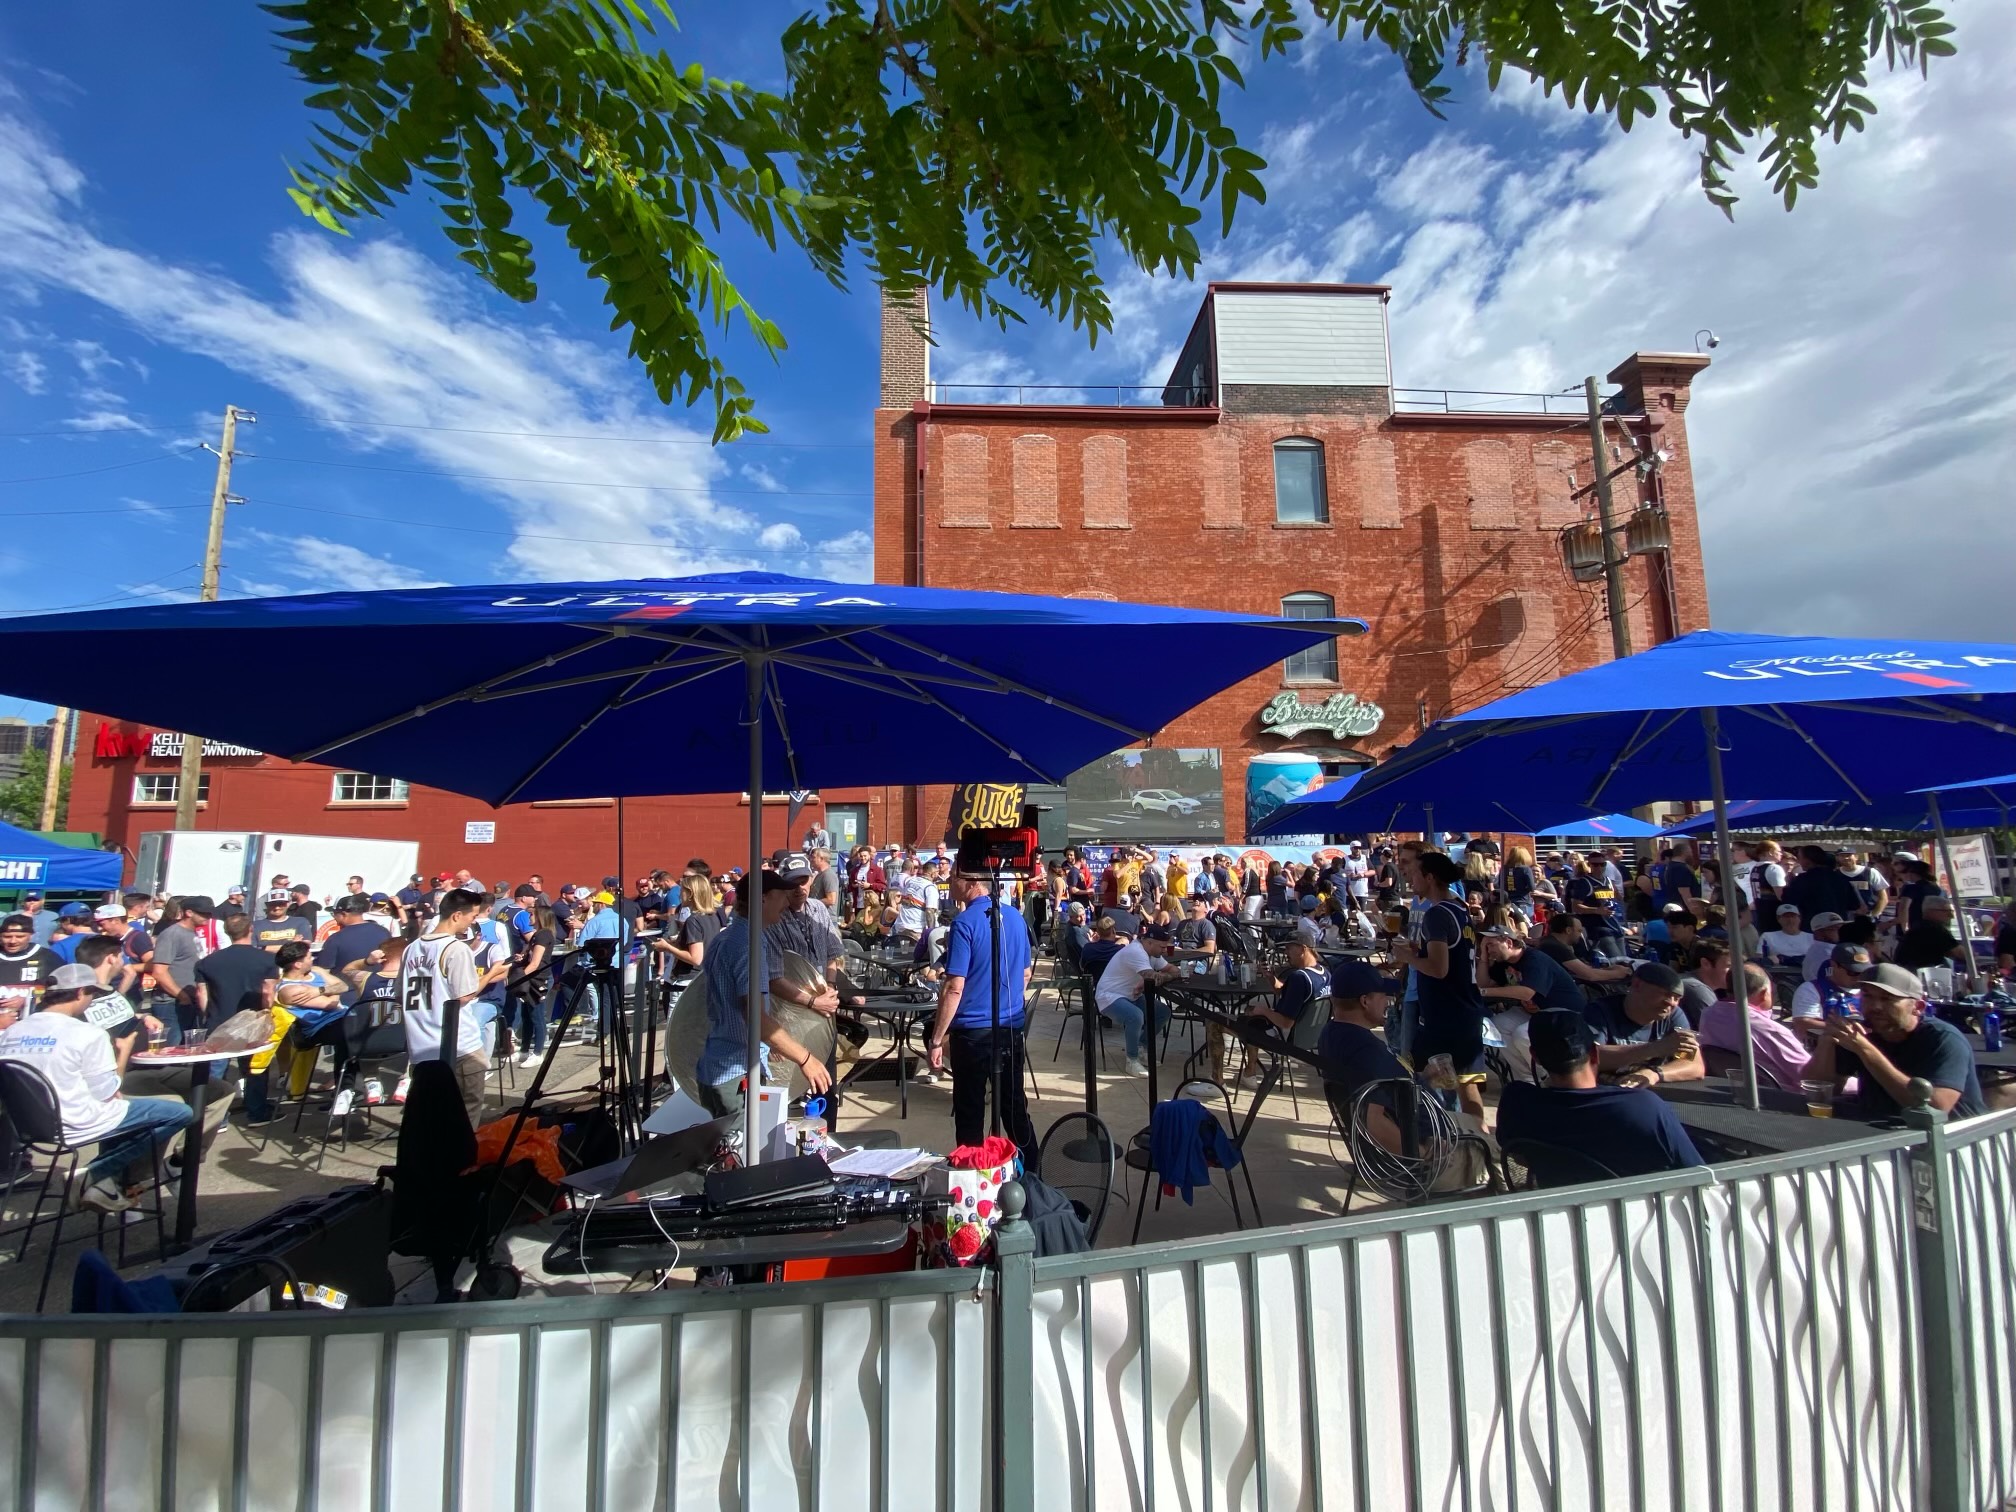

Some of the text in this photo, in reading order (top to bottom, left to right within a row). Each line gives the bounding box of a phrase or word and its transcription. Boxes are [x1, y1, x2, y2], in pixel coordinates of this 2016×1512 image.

[492, 597, 887, 607] ULTRA
[1702, 655, 2016, 680] ULTRA
[1728, 650, 1916, 668] Michelob
[1261, 690, 1385, 740] Brooklyn's
[153, 733, 186, 745] KELL
[151, 745, 184, 757] REALT
[407, 955, 436, 973] MURRAY
[21, 967, 38, 981] 15
[405, 976, 433, 1011] 27
[370, 1001, 401, 1027] 15
[20, 1035, 57, 1046] Honda
